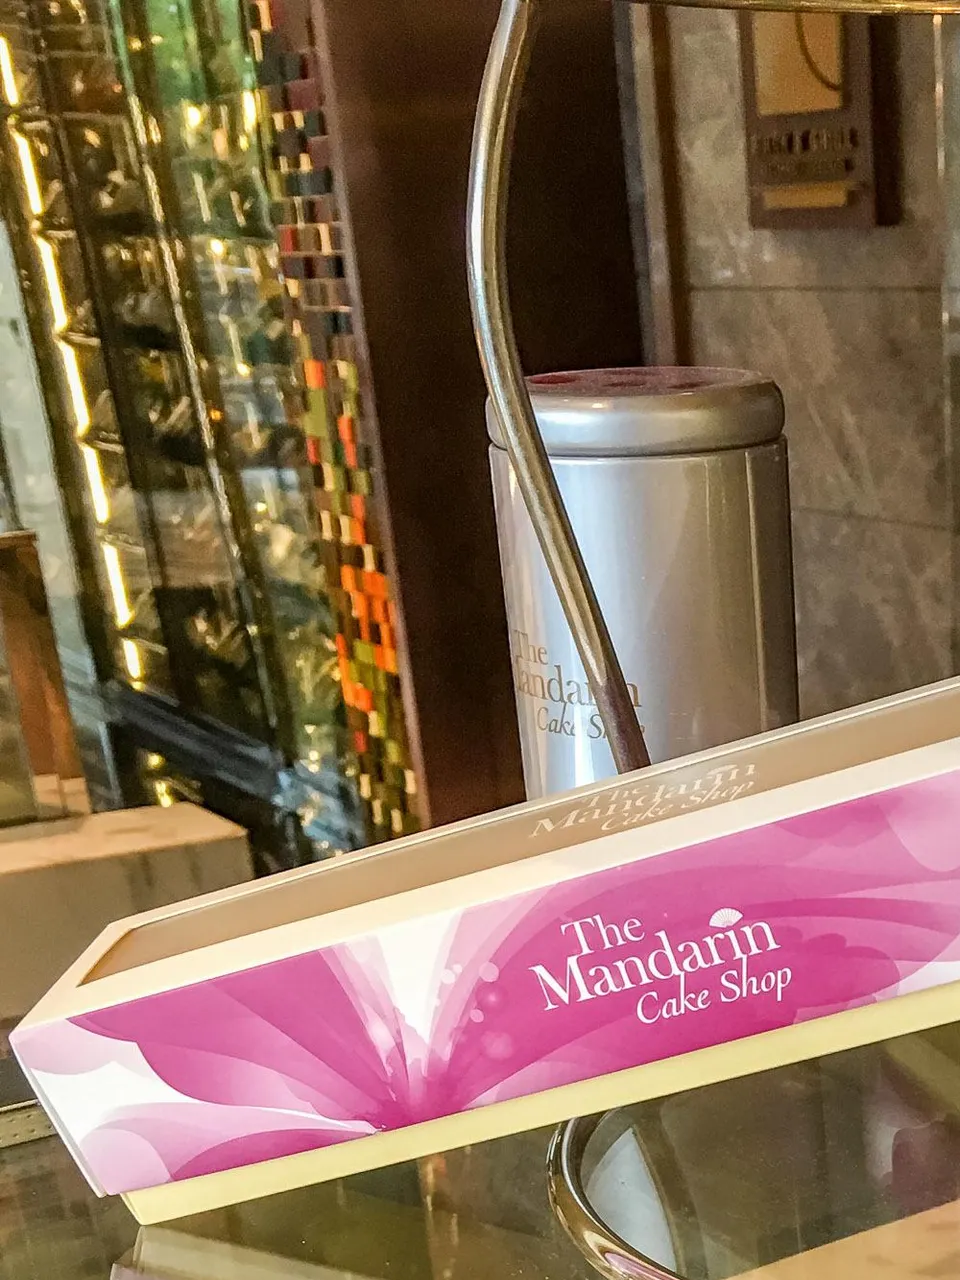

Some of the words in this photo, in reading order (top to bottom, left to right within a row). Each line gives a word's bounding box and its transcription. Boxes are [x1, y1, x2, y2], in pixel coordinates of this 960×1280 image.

[513, 629, 548, 665] The
[601, 798, 675, 832] Cake
[681, 781, 755, 810] Shop
[560, 913, 646, 956] The
[528, 920, 781, 1012] Mandarin
[636, 971, 712, 1024] Cake
[720, 955, 793, 1002] Shop
